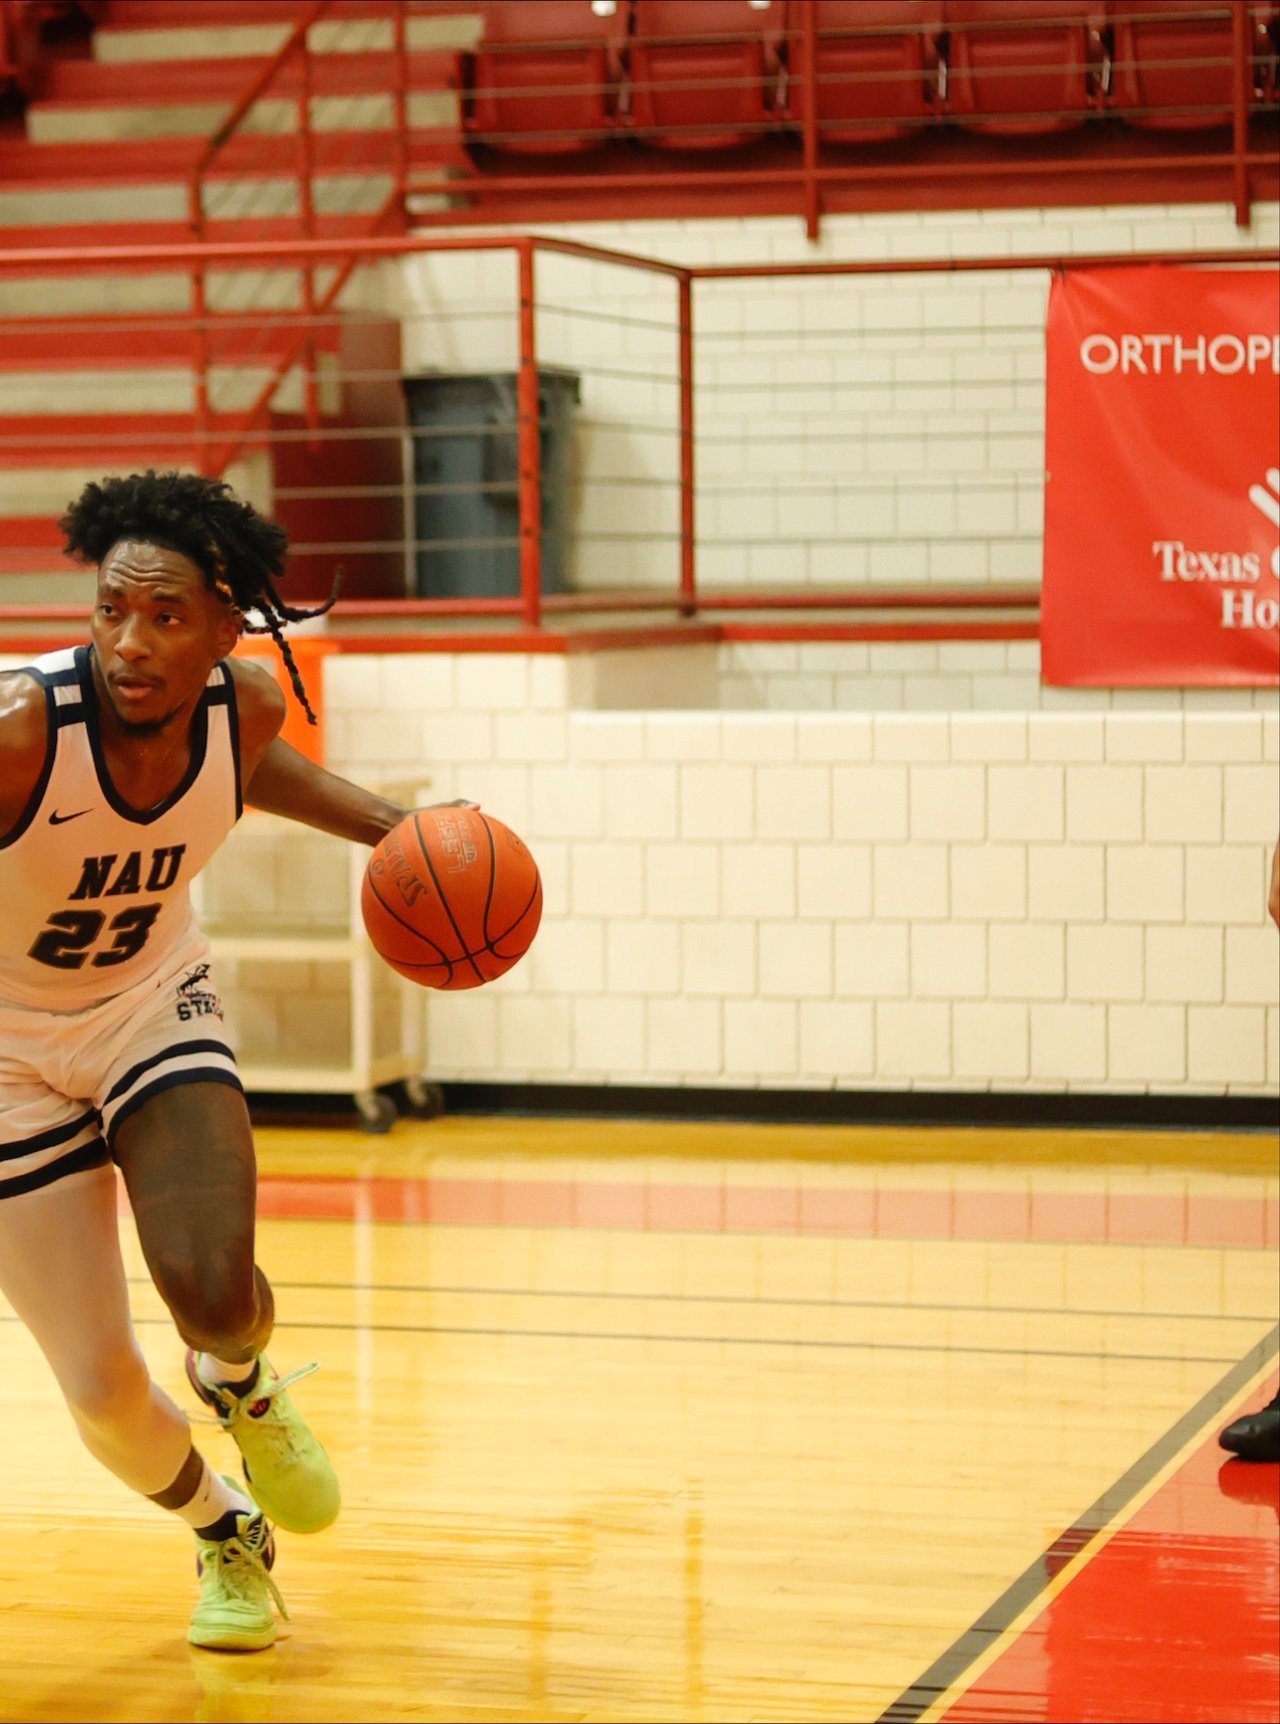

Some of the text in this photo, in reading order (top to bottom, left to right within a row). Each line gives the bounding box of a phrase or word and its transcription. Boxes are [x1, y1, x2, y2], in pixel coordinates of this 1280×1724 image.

[1152, 540, 1261, 582] Texas
[67, 843, 187, 900] NAU
[26, 902, 163, 970] 23
